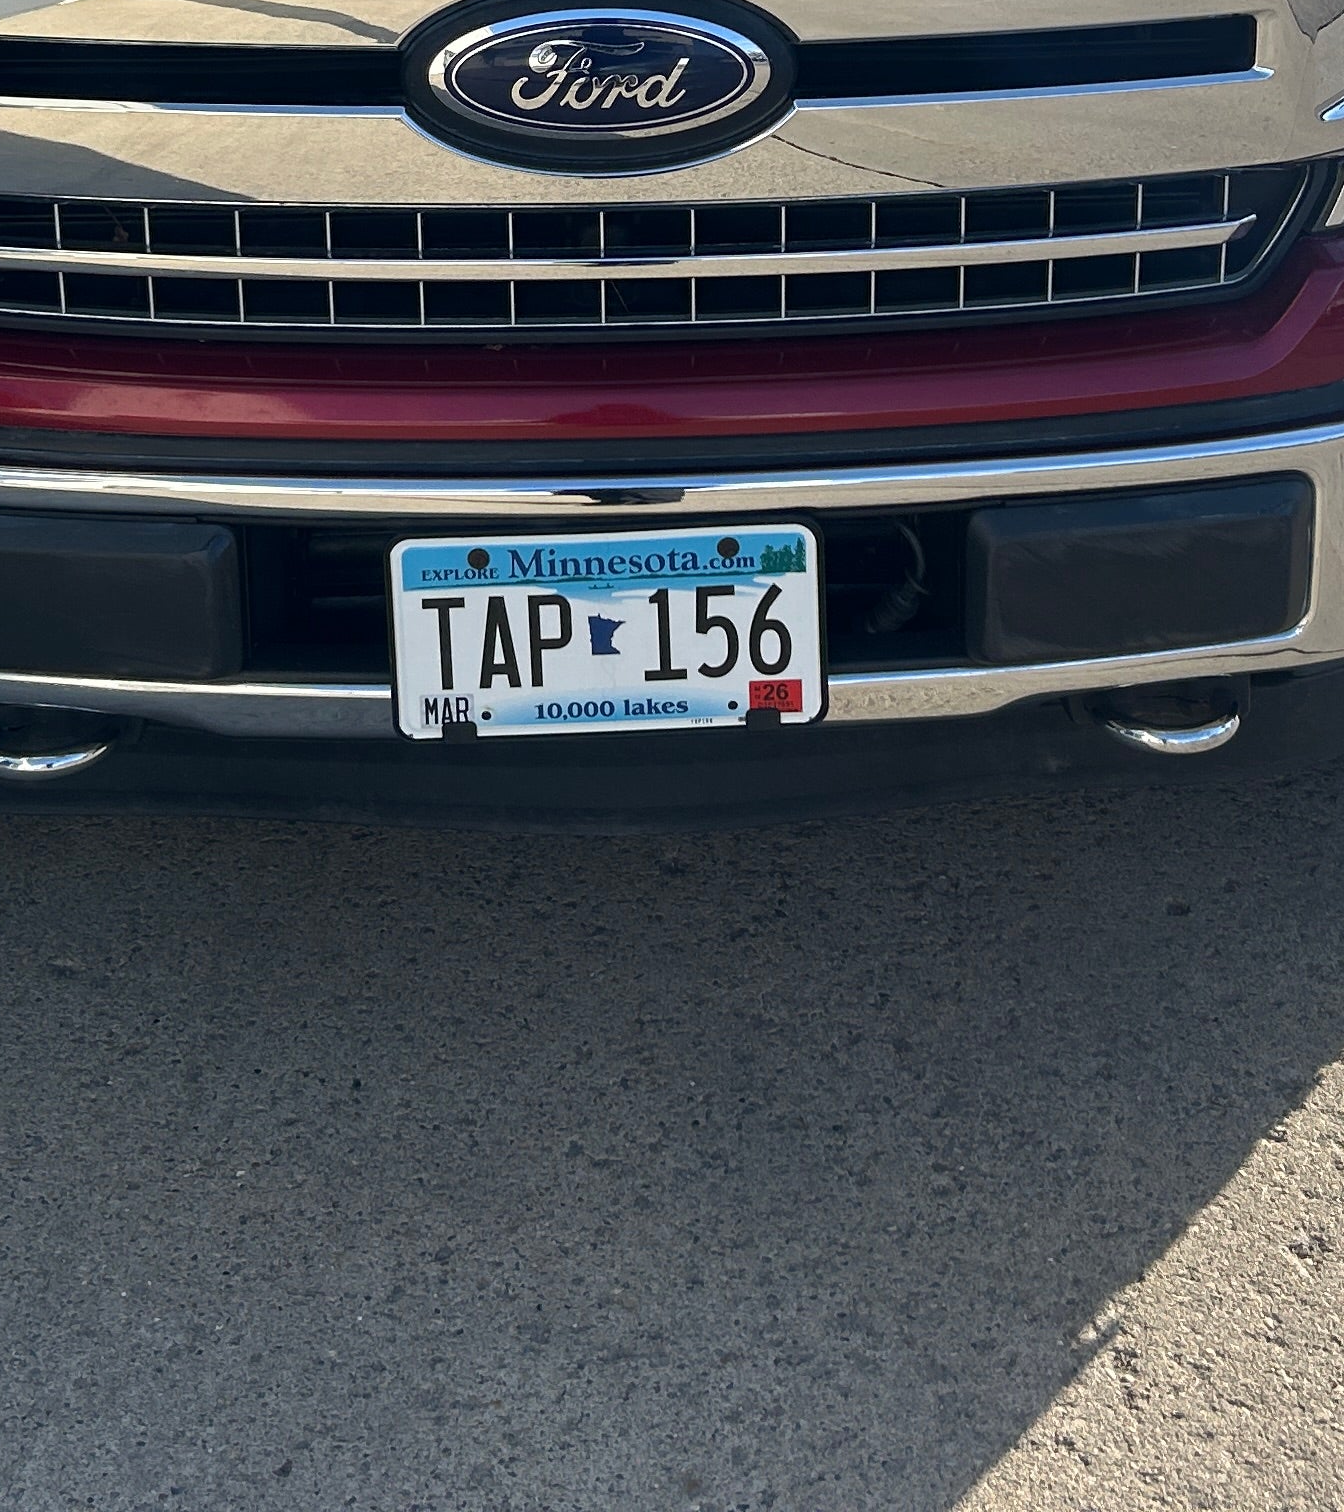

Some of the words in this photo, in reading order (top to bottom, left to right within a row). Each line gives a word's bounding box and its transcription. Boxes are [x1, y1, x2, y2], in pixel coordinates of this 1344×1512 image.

[510, 39, 689, 111] Ford
[421, 566, 499, 582] EXPLORE
[421, 594, 572, 690] TAP
[644, 583, 792, 682] 156
[762, 683, 789, 701] 26
[424, 696, 470, 725] MAR
[534, 700, 615, 721] 10,000
[623, 698, 689, 716] lakes
